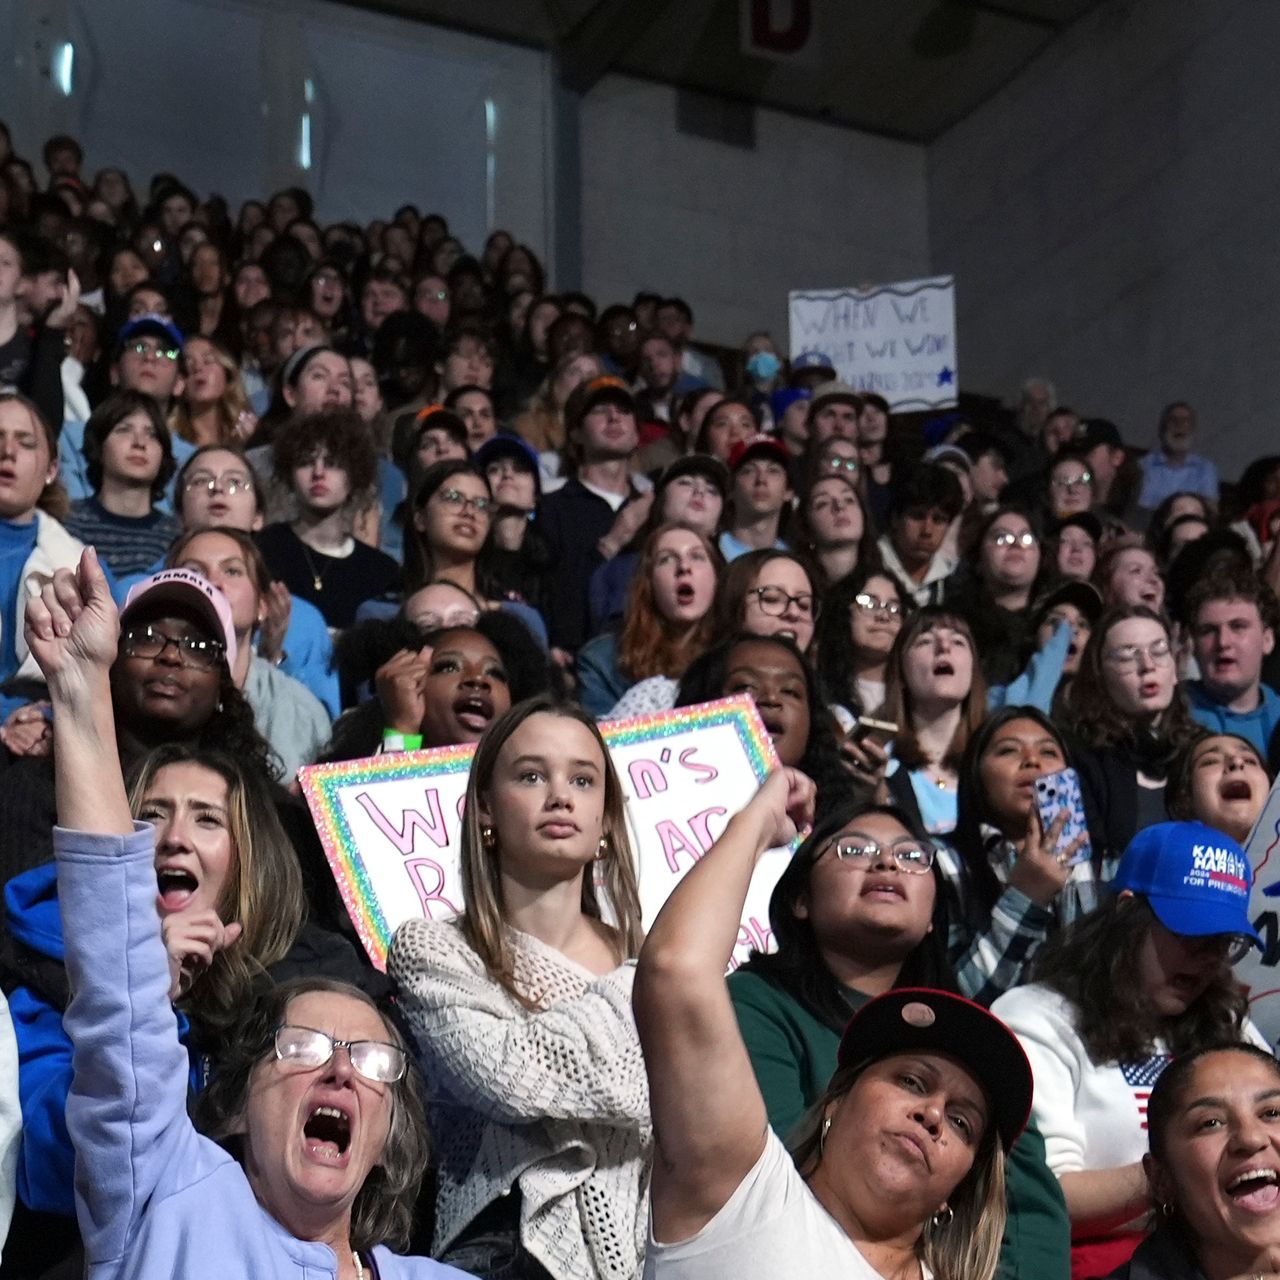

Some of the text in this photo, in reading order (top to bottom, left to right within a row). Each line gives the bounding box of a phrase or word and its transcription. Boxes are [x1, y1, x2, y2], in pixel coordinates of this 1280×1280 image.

[793, 300, 877, 334] WHEN
[1192, 845, 1244, 866] KAMALA
[1194, 856, 1246, 881] HARRIS
[1183, 876, 1205, 887] FOR
